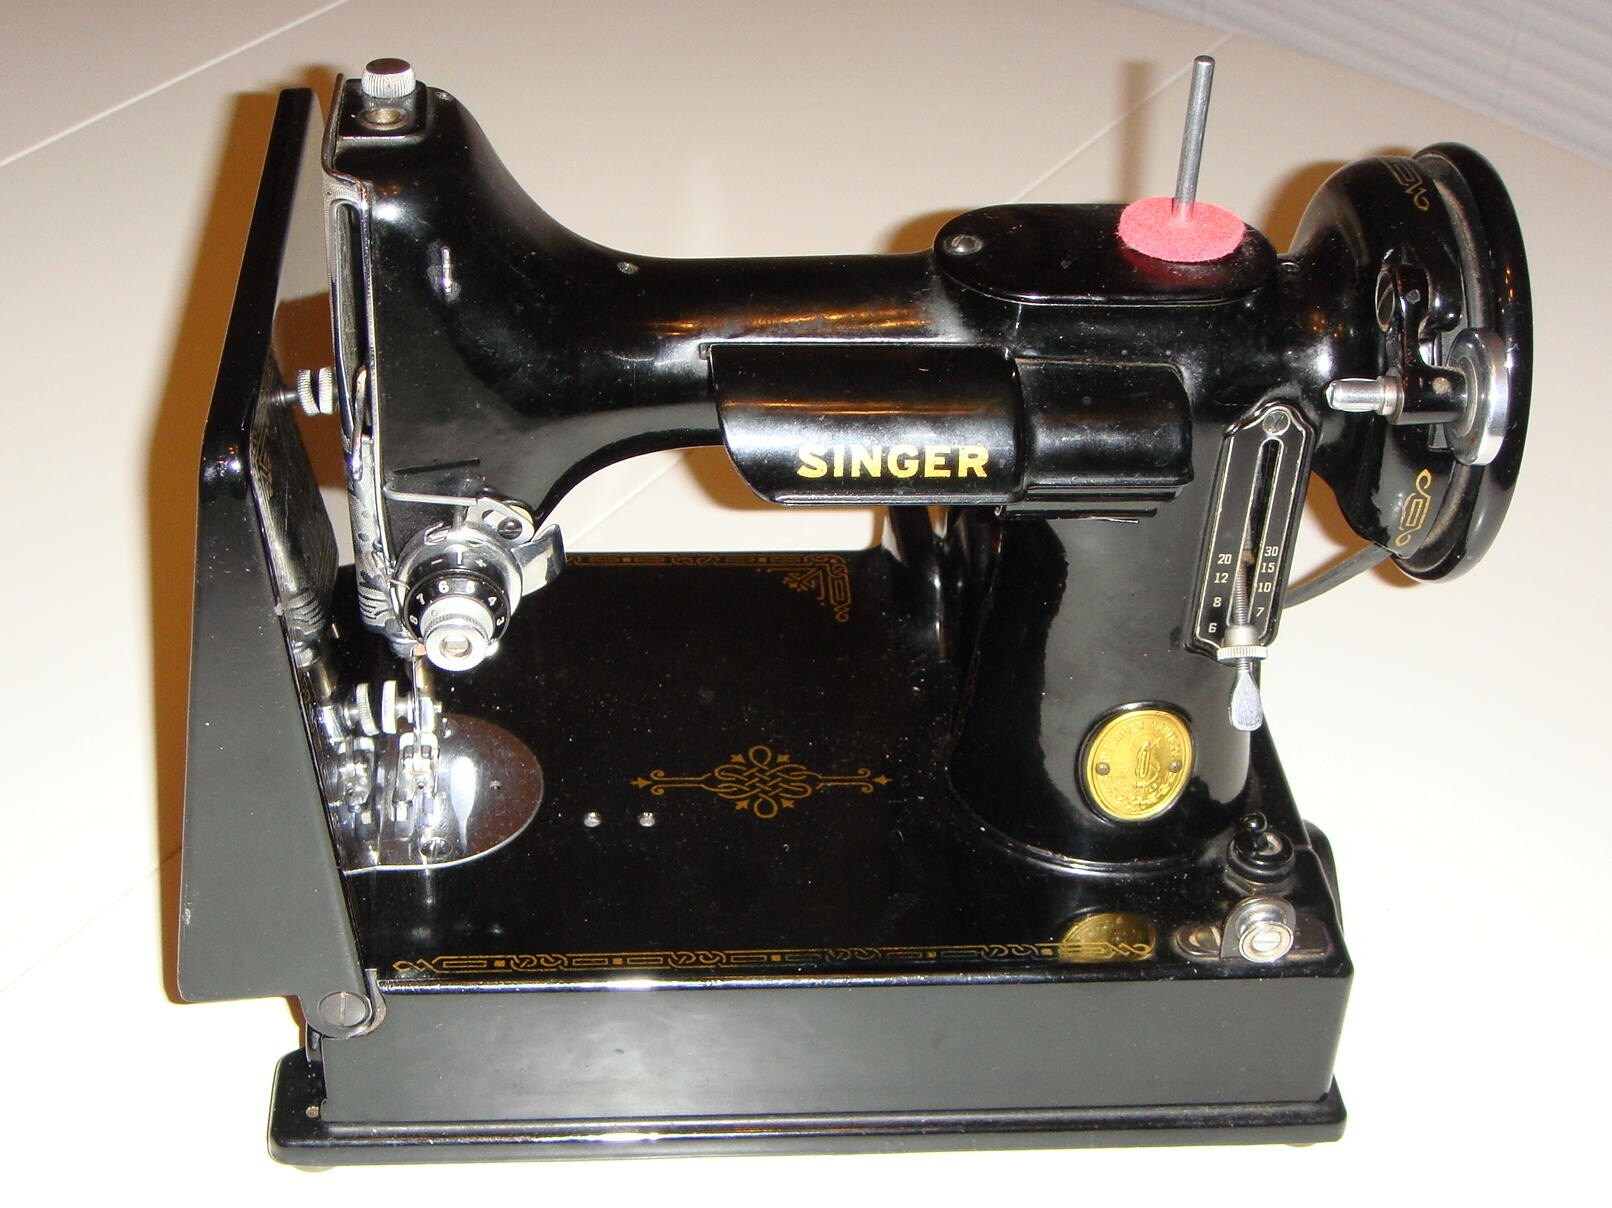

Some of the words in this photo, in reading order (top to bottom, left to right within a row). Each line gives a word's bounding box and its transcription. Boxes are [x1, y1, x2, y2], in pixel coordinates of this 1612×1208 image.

[797, 444, 989, 479] SINGER
[1264, 546, 1279, 557] 30
[1217, 553, 1232, 565] 20
[1261, 562, 1275, 572] 15
[1214, 572, 1229, 583] 12
[438, 580, 449, 594] 6
[1257, 582, 1272, 592] 10
[416, 593, 425, 605] 7
[487, 596, 497, 607] 4
[1212, 596, 1222, 607] 8
[1255, 607, 1265, 617] 7
[496, 616, 505, 626] 3
[1208, 622, 1218, 633] 6
